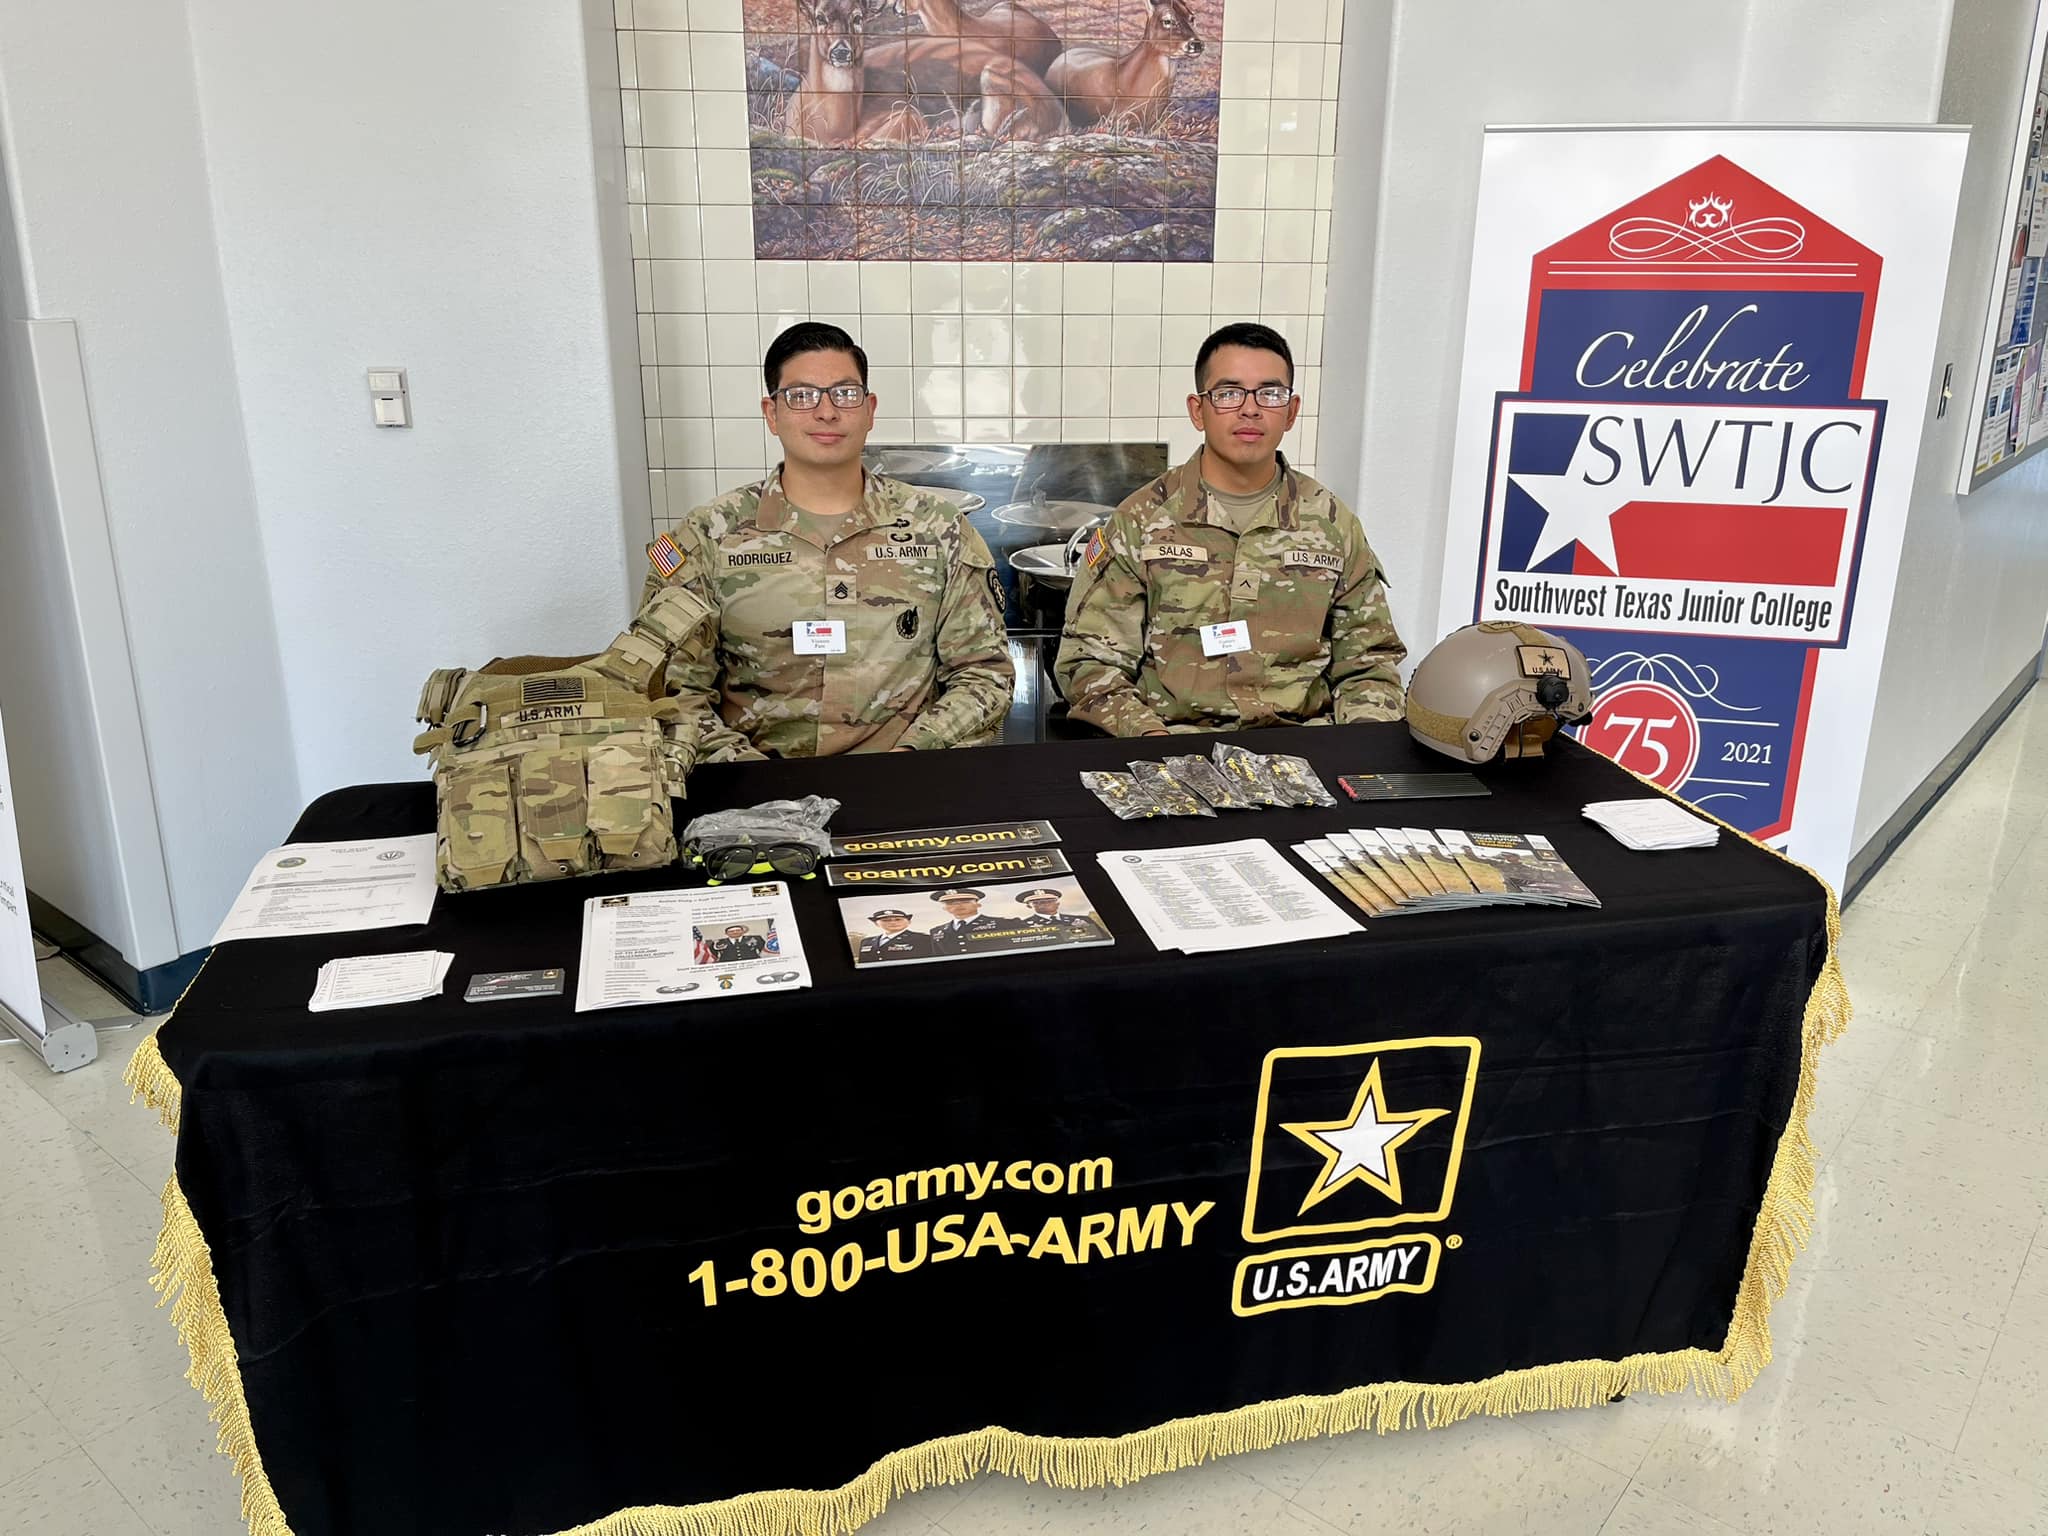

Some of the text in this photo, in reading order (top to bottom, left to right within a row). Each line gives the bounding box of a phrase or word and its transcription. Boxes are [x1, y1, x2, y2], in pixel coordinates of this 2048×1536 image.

[1575, 304, 1811, 392] Celebrate
[1582, 414, 1862, 504] SWTJC
[728, 551, 793, 567] RODRIGUEZ
[899, 546, 929, 558] ARMY
[1159, 545, 1193, 558] SALAS
[1313, 554, 1341, 568] ARMY
[1494, 577, 1833, 632] Southwest Texas Junior College
[1603, 712, 1678, 779] 75
[1720, 741, 1773, 765] 2021
[843, 829, 1017, 851] goarmy.com
[843, 858, 1025, 881] goarmy.com
[796, 1157, 1113, 1235] goarmy.com
[688, 1201, 1215, 1307] 1-800-USA-ARMY
